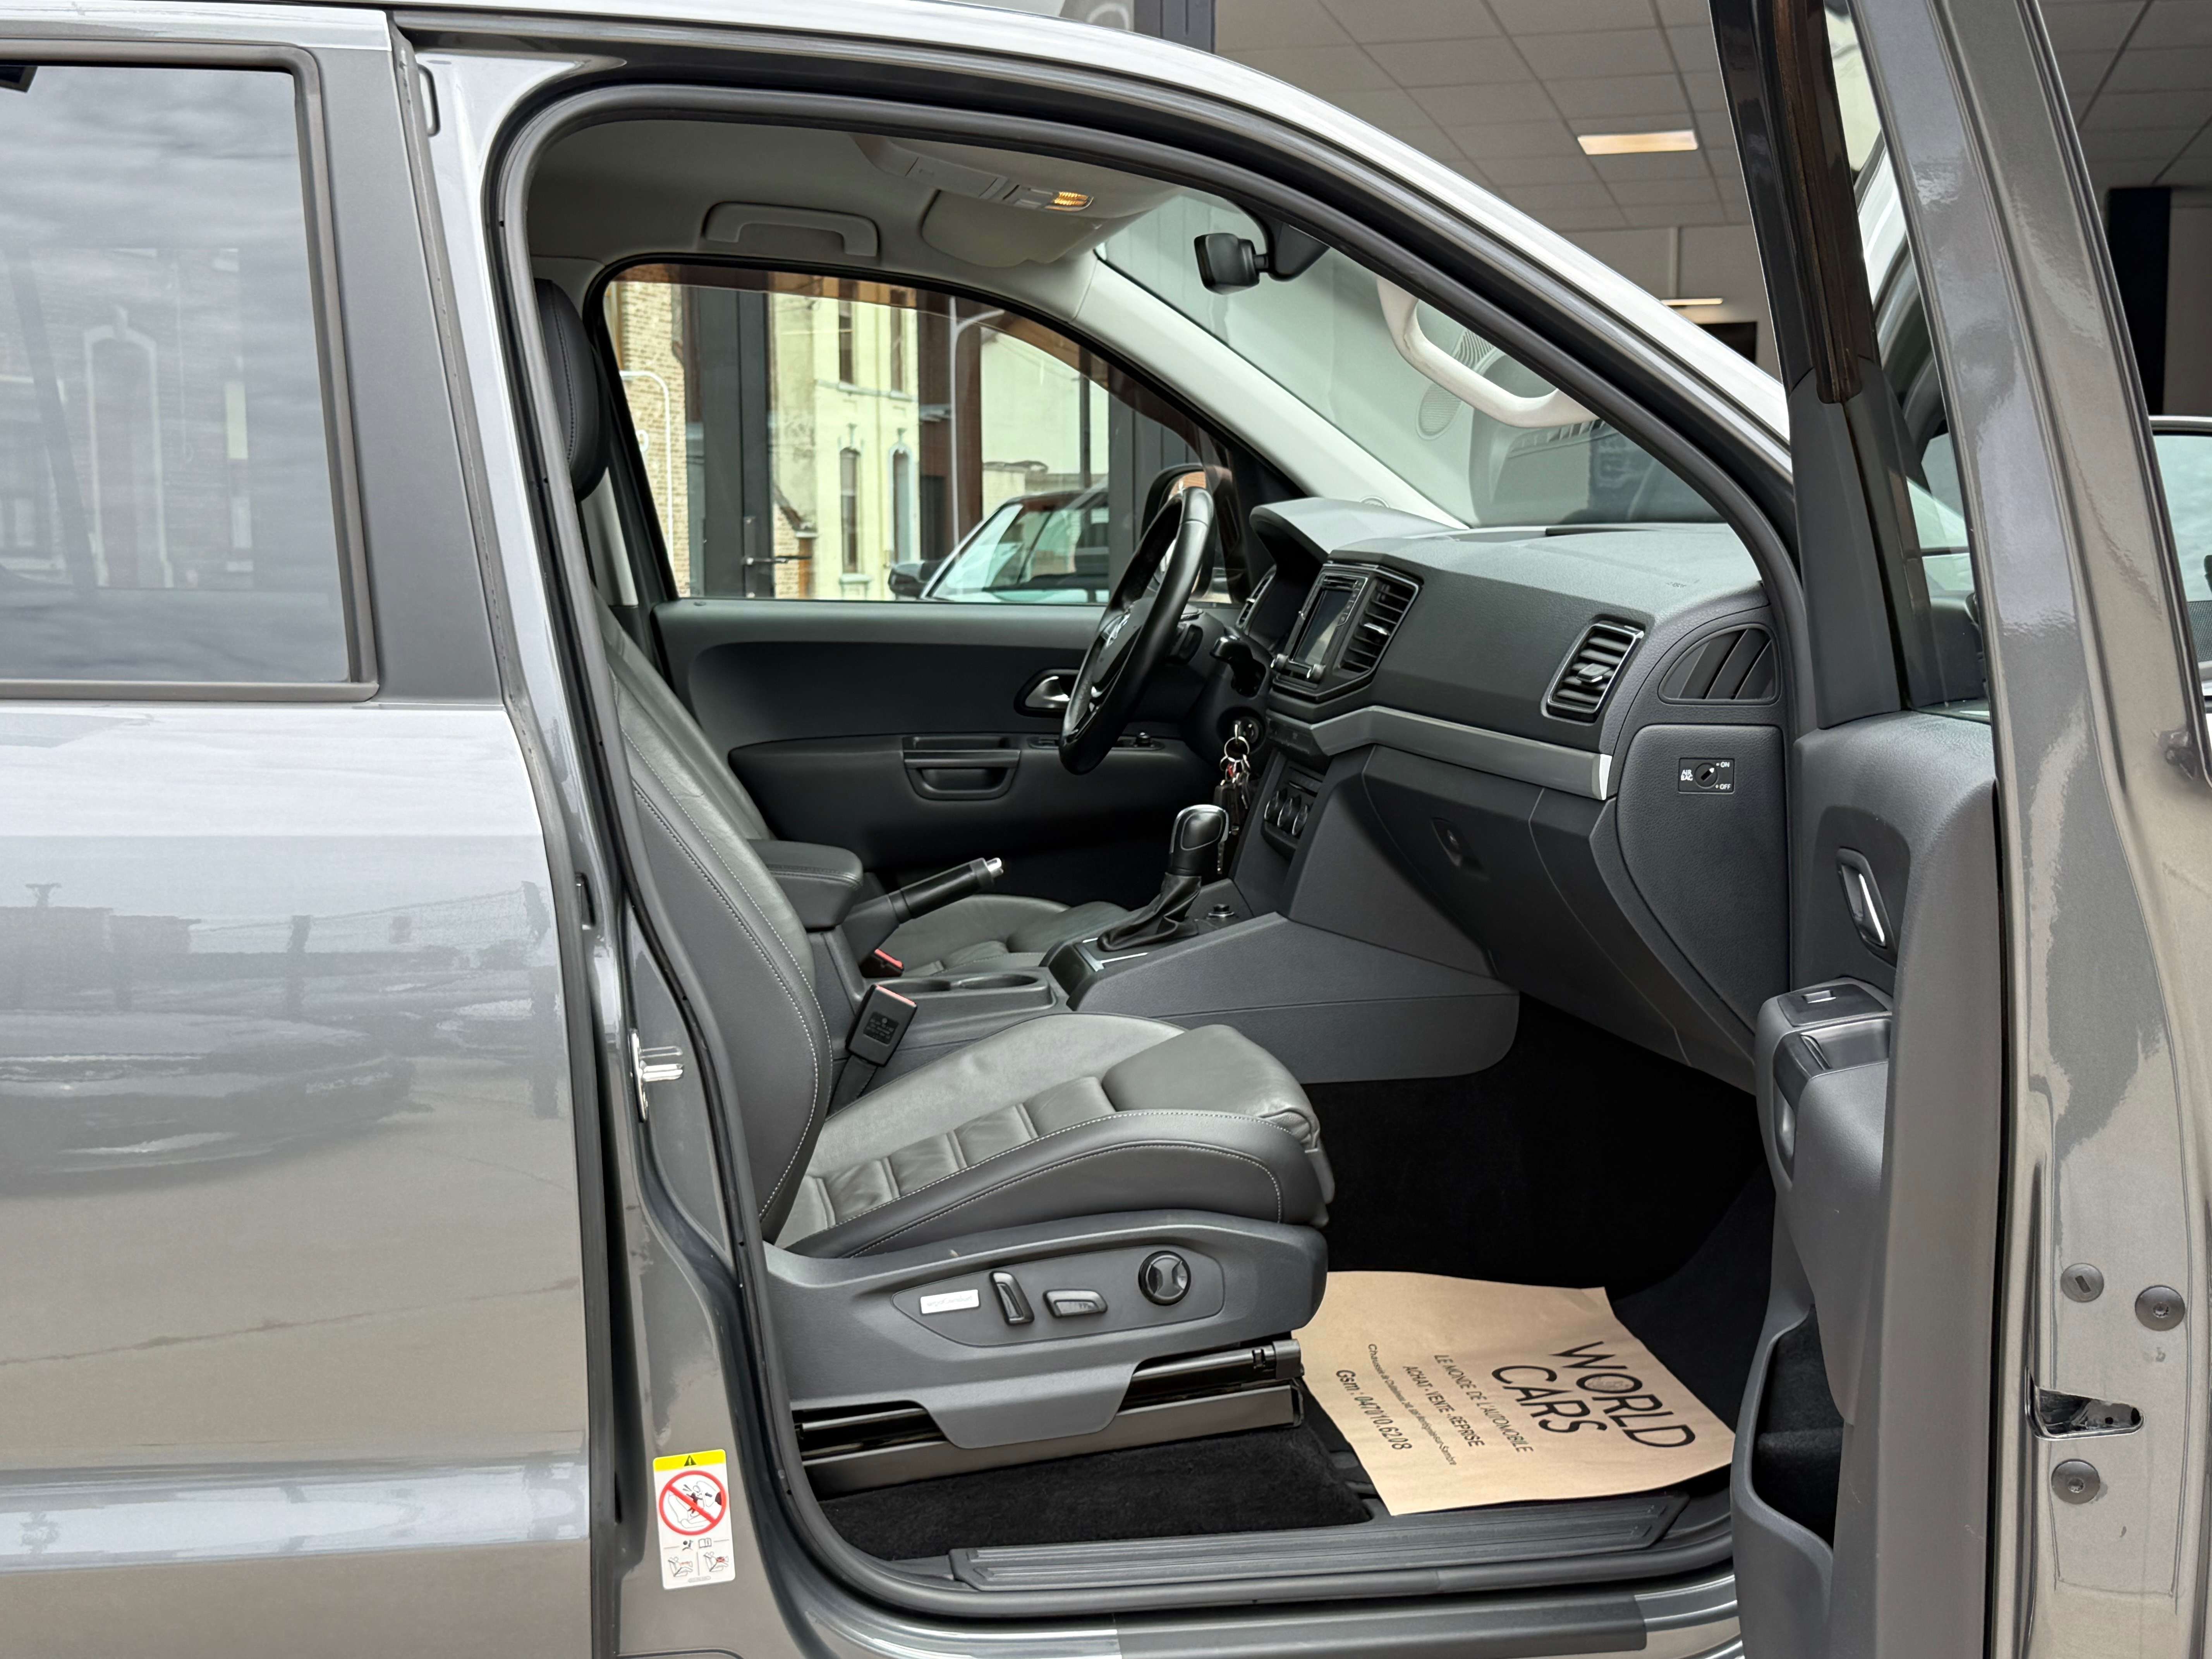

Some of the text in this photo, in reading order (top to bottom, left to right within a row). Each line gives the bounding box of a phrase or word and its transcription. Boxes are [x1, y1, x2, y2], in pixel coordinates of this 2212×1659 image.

[1434, 1355, 1453, 1364] LE
[1443, 1365, 1477, 1389] MONDE
[1402, 1366, 1433, 1388] ACHAT
[1425, 1391, 1455, 1413] VENTE
[1466, 1391, 1487, 1400] DE
[1492, 1365, 1607, 1433] CARS
[1549, 1341, 1695, 1448] WORLD
